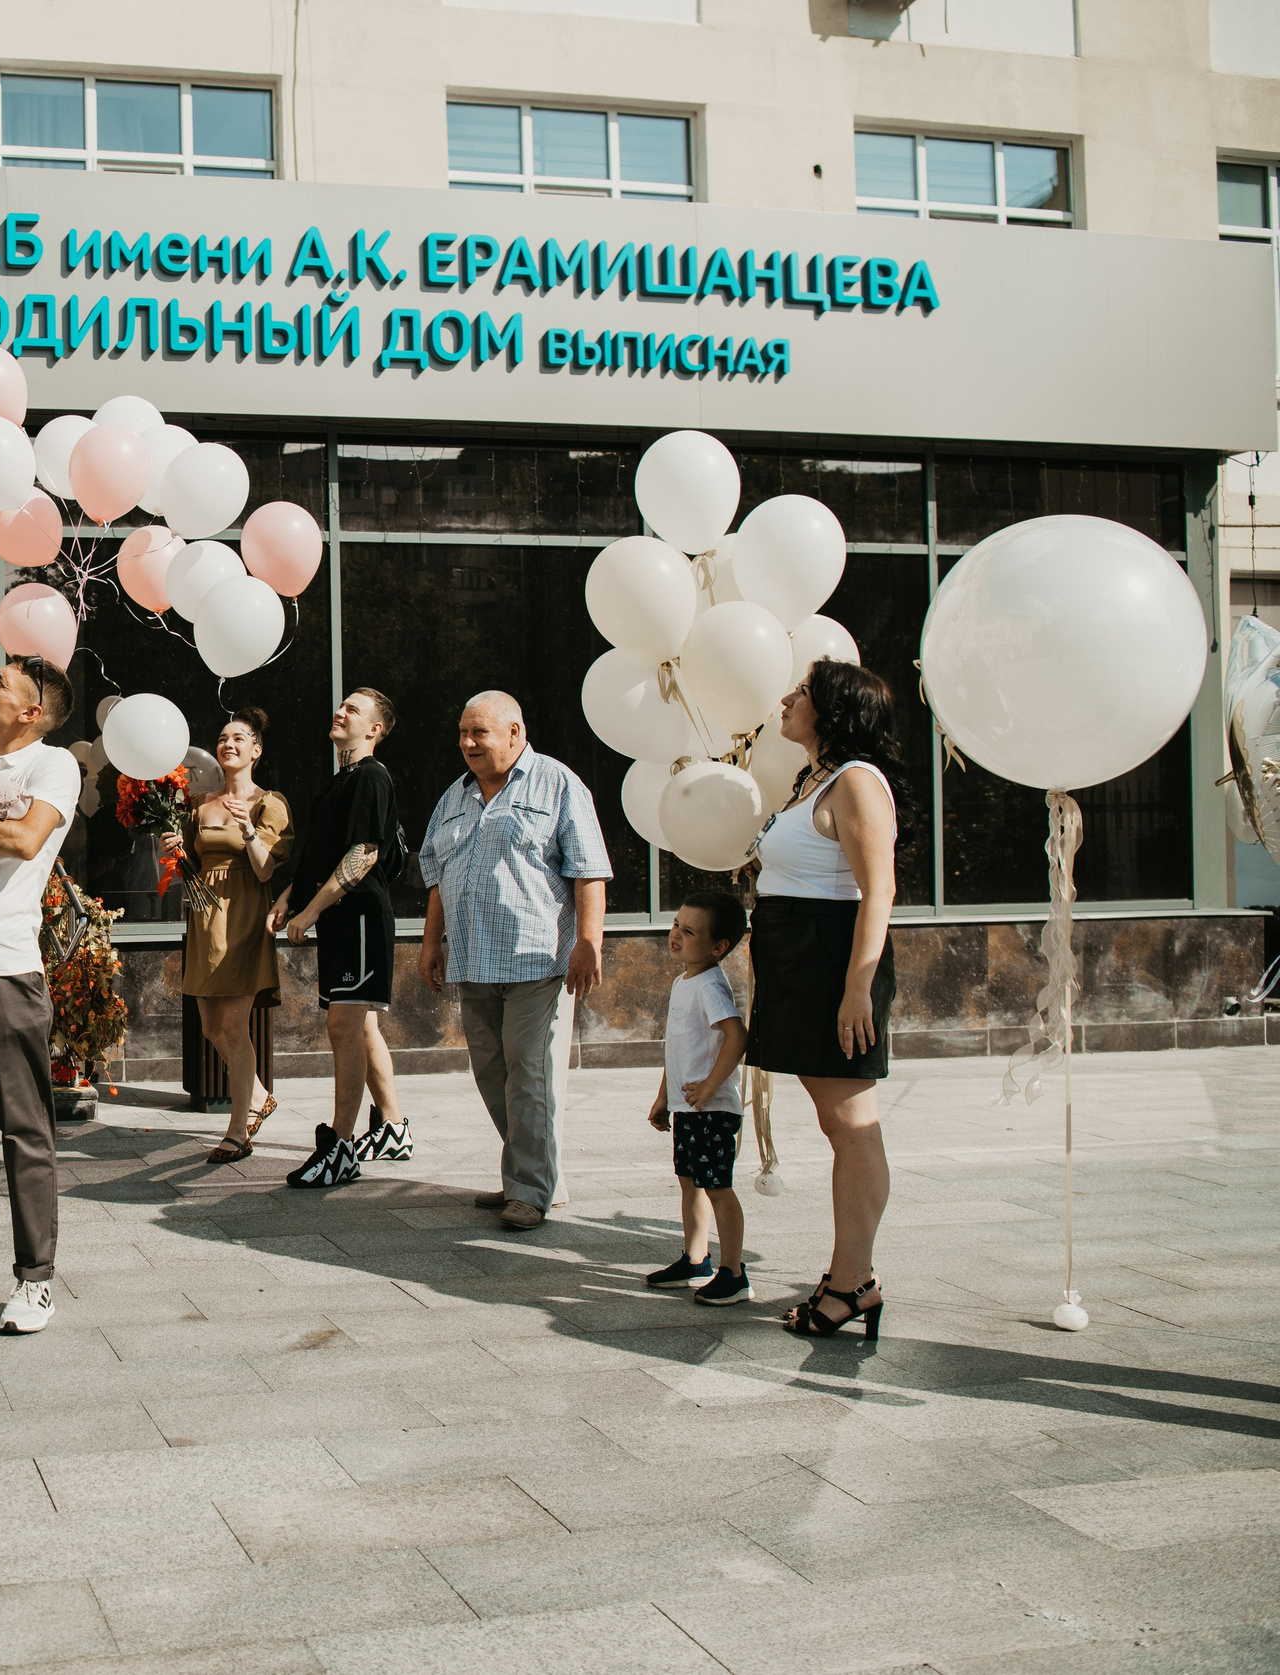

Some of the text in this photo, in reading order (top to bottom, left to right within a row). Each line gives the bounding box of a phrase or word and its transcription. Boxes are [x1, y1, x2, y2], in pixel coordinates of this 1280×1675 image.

[66, 228, 273, 279] имени
[423, 232, 941, 314] ЕРАМИШАНЦЕВА
[379, 308, 524, 371] ДОМ
[544, 328, 791, 376] ВЫПИСНАЯ
